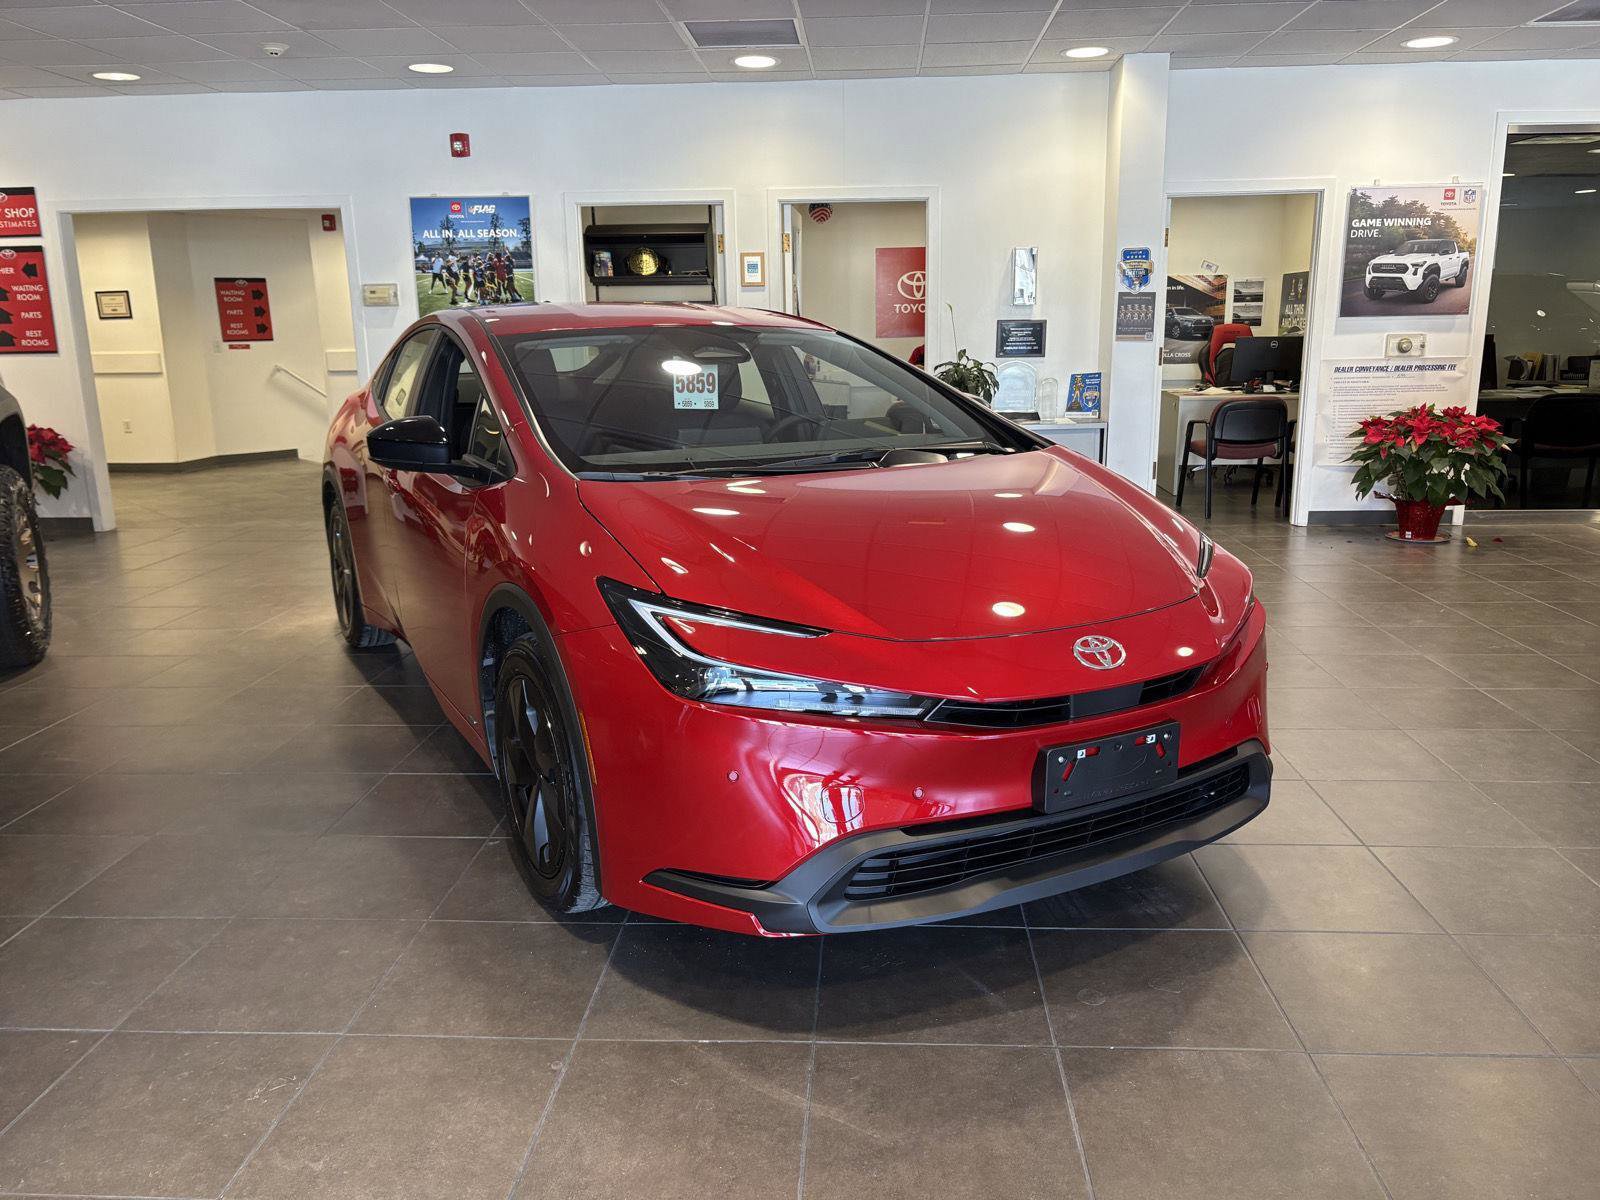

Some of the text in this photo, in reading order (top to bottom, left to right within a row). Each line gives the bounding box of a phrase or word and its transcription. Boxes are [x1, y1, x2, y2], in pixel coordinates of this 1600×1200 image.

[4, 207, 35, 218] SHOP
[472, 204, 496, 214] FLAG
[1351, 217, 1432, 228] GAME WINNING
[422, 229, 520, 239] ALL IN. ALL SEASON.
[1350, 229, 1381, 238] DRIVE.
[11, 284, 44, 292] WAITING
[20, 311, 42, 319] PARTS
[1354, 365, 1390, 373] CONVEYANCE
[1413, 364, 1446, 372] PROCESSING
[1446, 363, 1457, 371] FEE
[675, 372, 716, 394] 5859
